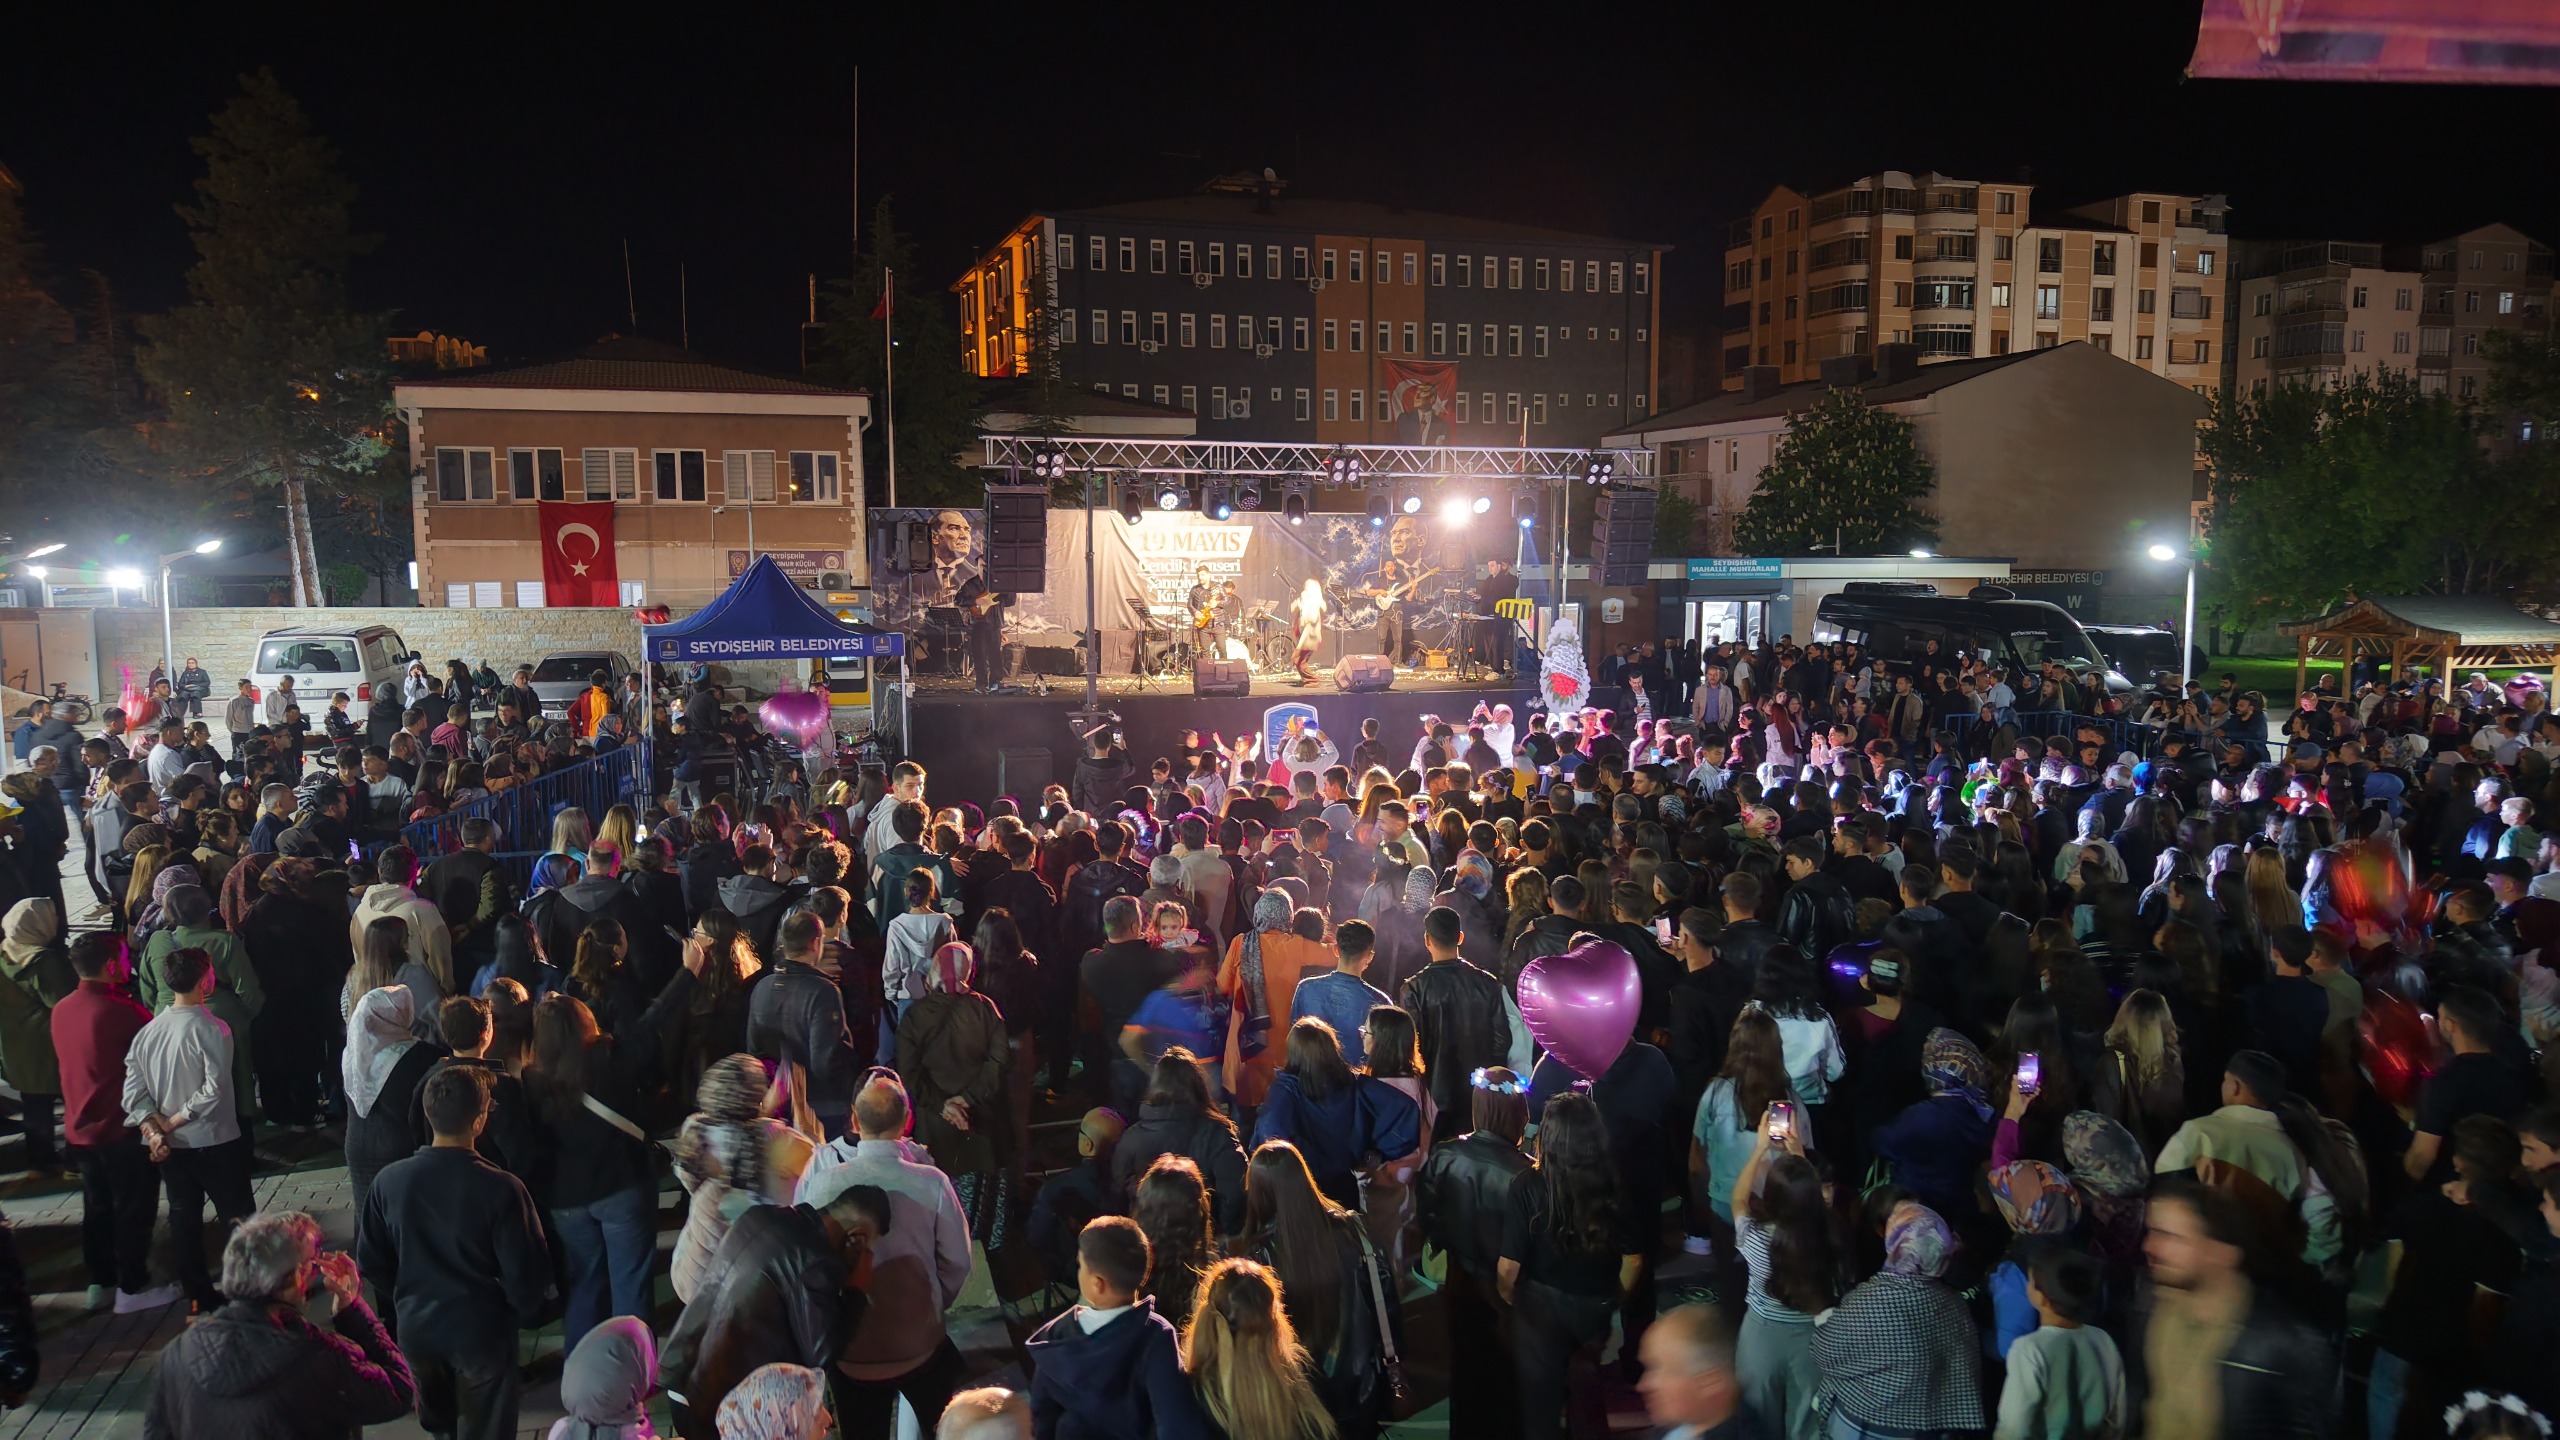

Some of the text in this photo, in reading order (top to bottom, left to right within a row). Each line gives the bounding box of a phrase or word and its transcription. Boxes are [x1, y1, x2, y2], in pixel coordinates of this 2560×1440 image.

[1140, 531, 1241, 551] 19 MAYIS
[795, 560, 816, 568] KÜÇÜK
[1729, 565, 1778, 573] MUHTARLARI
[1985, 572, 2090, 586] YDİŞEHİR BELEDİYESİ
[2067, 595, 2082, 609] W
[690, 639, 775, 654] SEYDİŞEHİR
[780, 637, 864, 651] BELEDİYESİ
